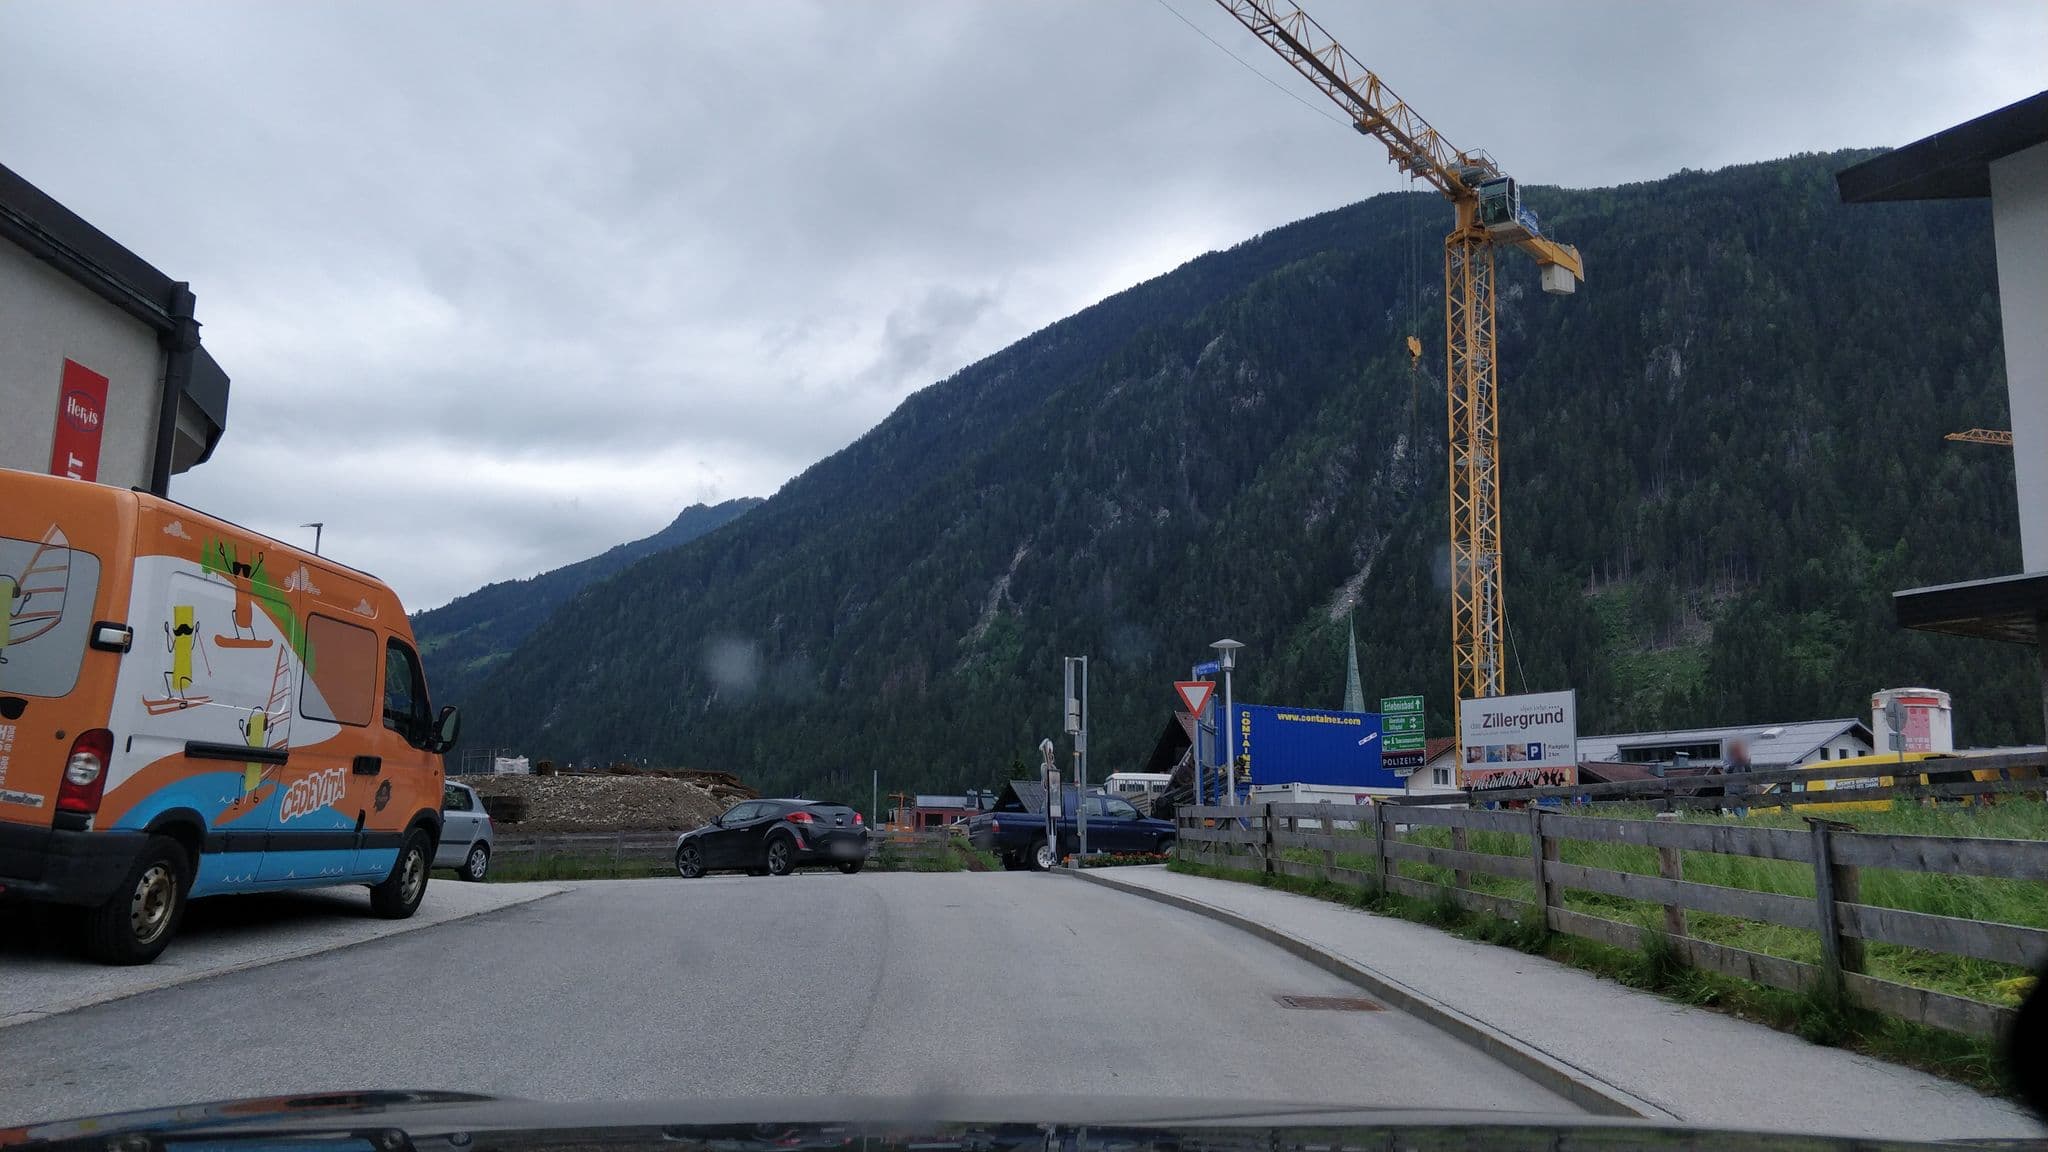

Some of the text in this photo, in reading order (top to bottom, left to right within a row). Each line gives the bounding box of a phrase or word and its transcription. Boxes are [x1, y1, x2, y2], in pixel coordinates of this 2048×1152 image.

[67, 396, 98, 424] Hervis
[1276, 713, 1361, 726] www.containex.com
[1482, 708, 1564, 730] Zillergrund
[1383, 756, 1411, 767] POLIZEI
[280, 768, 346, 823] CEDEVITA
